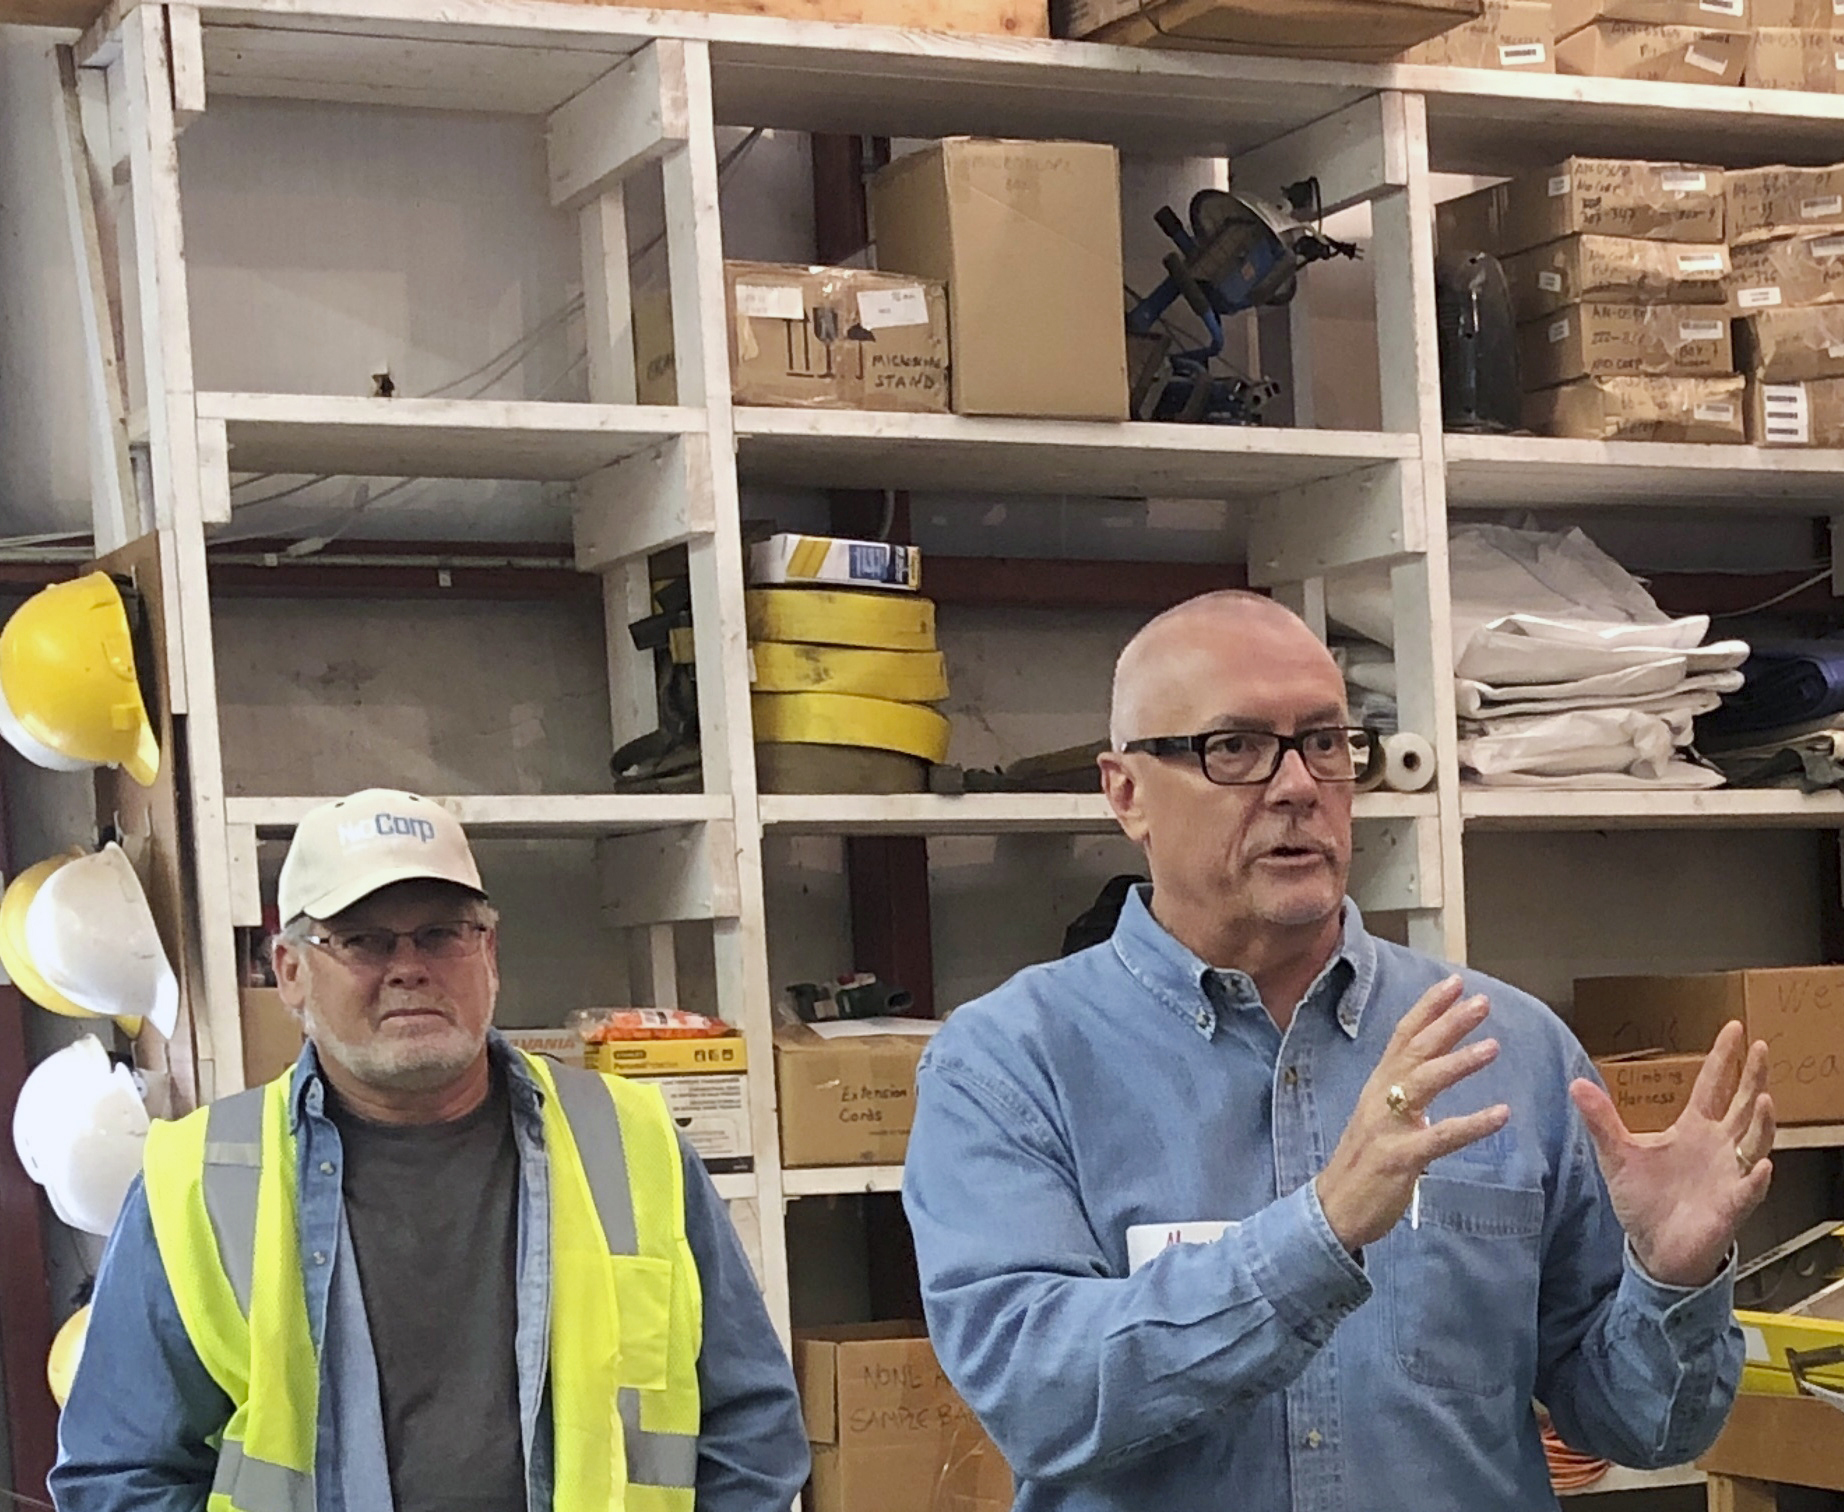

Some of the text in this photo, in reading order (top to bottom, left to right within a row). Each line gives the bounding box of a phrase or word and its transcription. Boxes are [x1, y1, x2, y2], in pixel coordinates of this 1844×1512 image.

[875, 371, 935, 389] STAND
[841, 1085, 907, 1102] Extension
[1618, 1090, 1675, 1107] Harness
[839, 1108, 882, 1123] Cords
